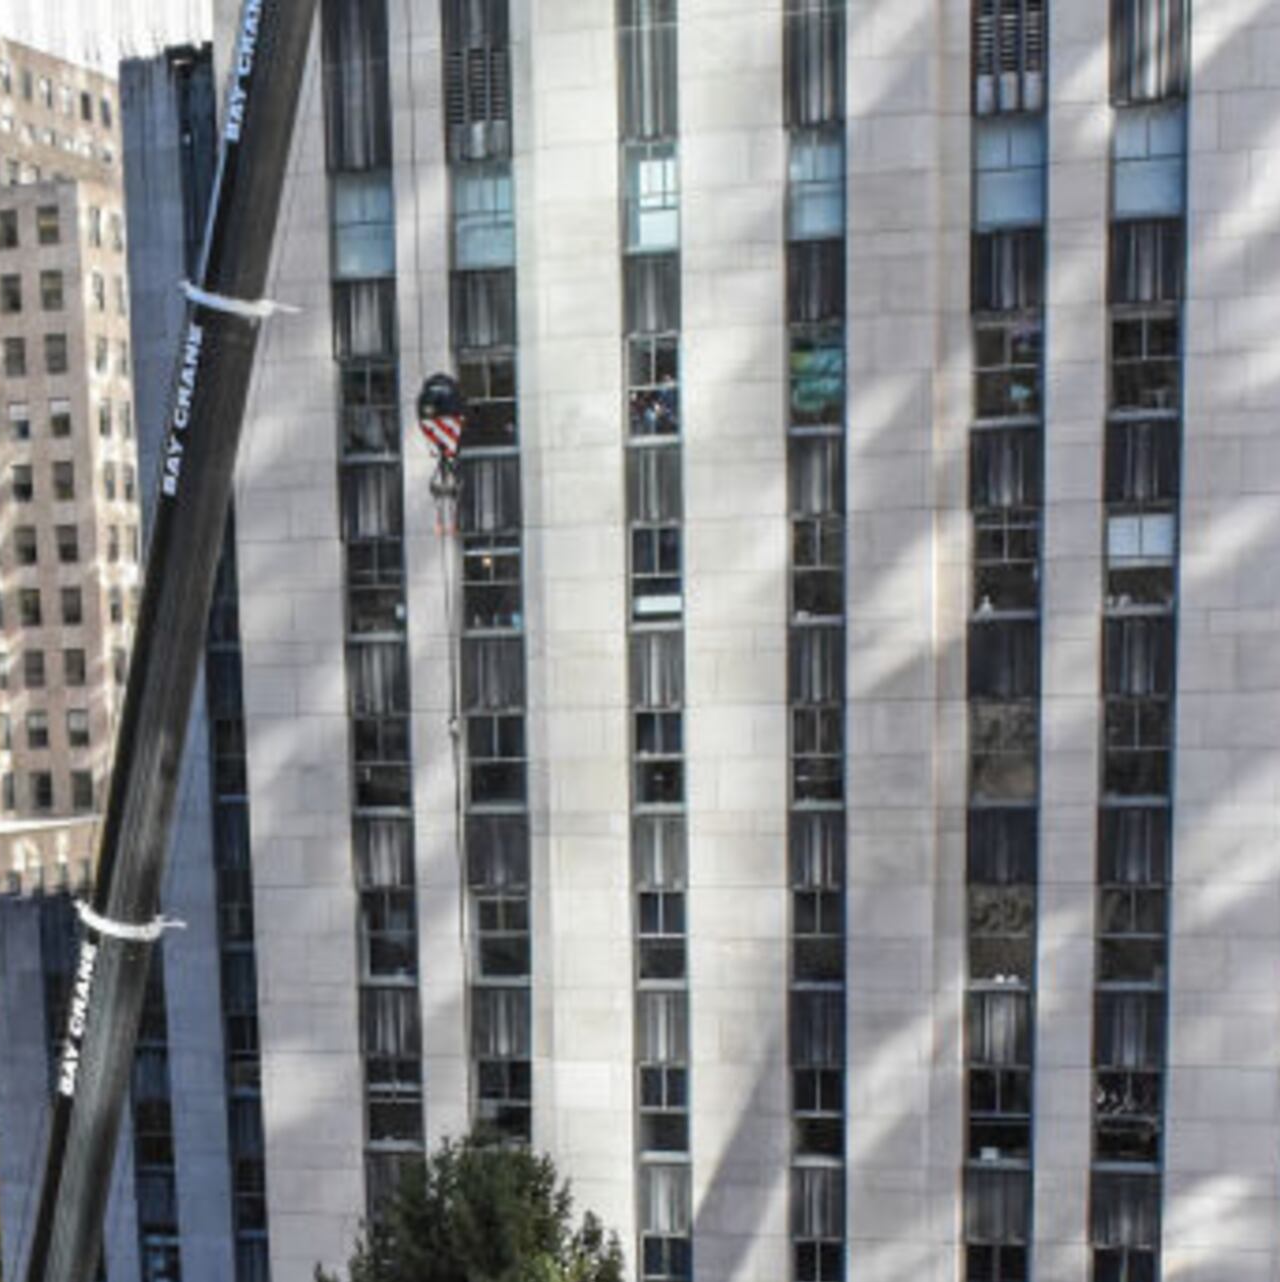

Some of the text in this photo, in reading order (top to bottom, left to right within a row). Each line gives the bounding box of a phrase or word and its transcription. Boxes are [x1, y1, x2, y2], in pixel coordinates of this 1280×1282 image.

[225, 0, 261, 142] BAY CRAN
[162, 322, 203, 496] BAY CRANE
[58, 941, 98, 1096] BAY CRANE
